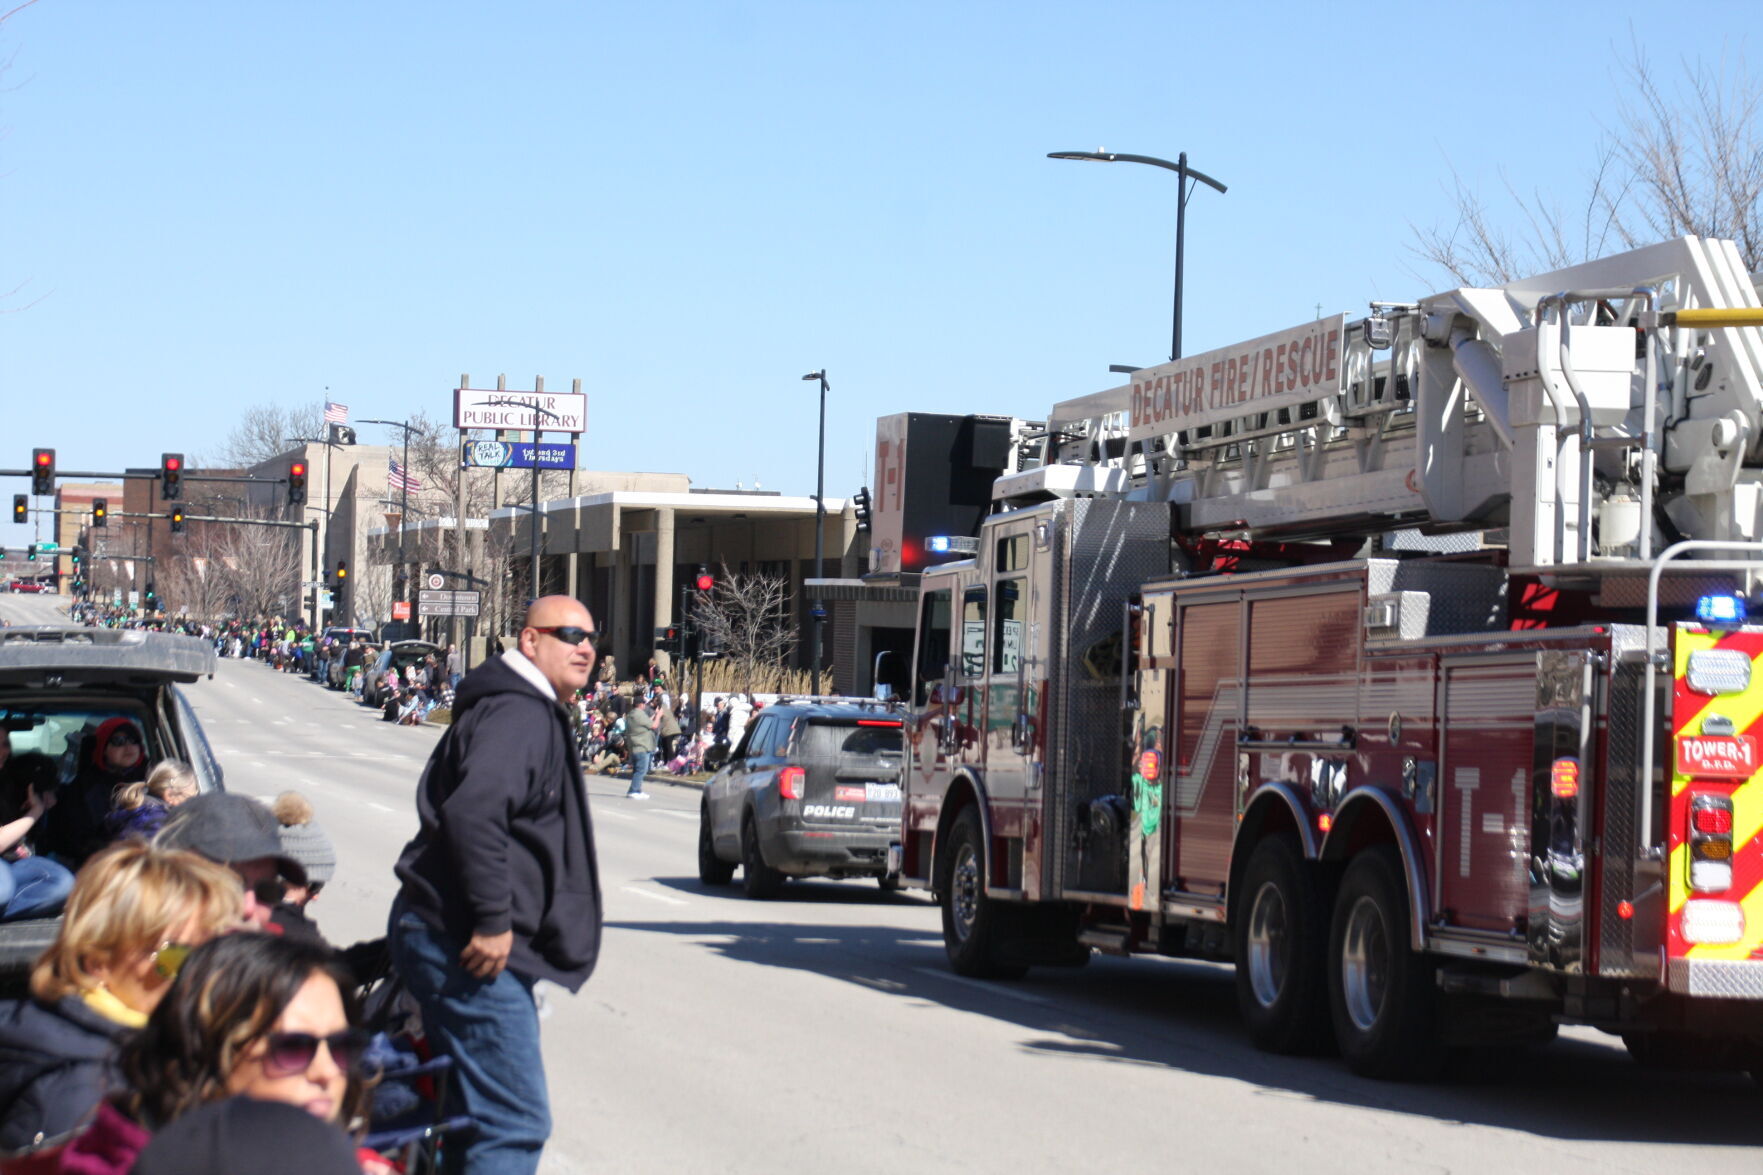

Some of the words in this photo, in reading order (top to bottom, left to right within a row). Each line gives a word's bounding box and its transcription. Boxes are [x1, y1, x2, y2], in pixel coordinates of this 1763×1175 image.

[1132, 367, 1204, 427] DECATUR
[1210, 329, 1338, 409] FIRE/RESCUE
[488, 394, 556, 410] DECATUR
[463, 411, 515, 425] PUBLIC
[520, 413, 580, 427] LIBRARY
[478, 442, 500, 452] REAL
[479, 450, 501, 460] TALK
[460, 606, 476, 614] Park
[1682, 740, 1752, 766] TOWER-1
[803, 805, 856, 819] POLICE
[1455, 767, 1526, 883] T-1
